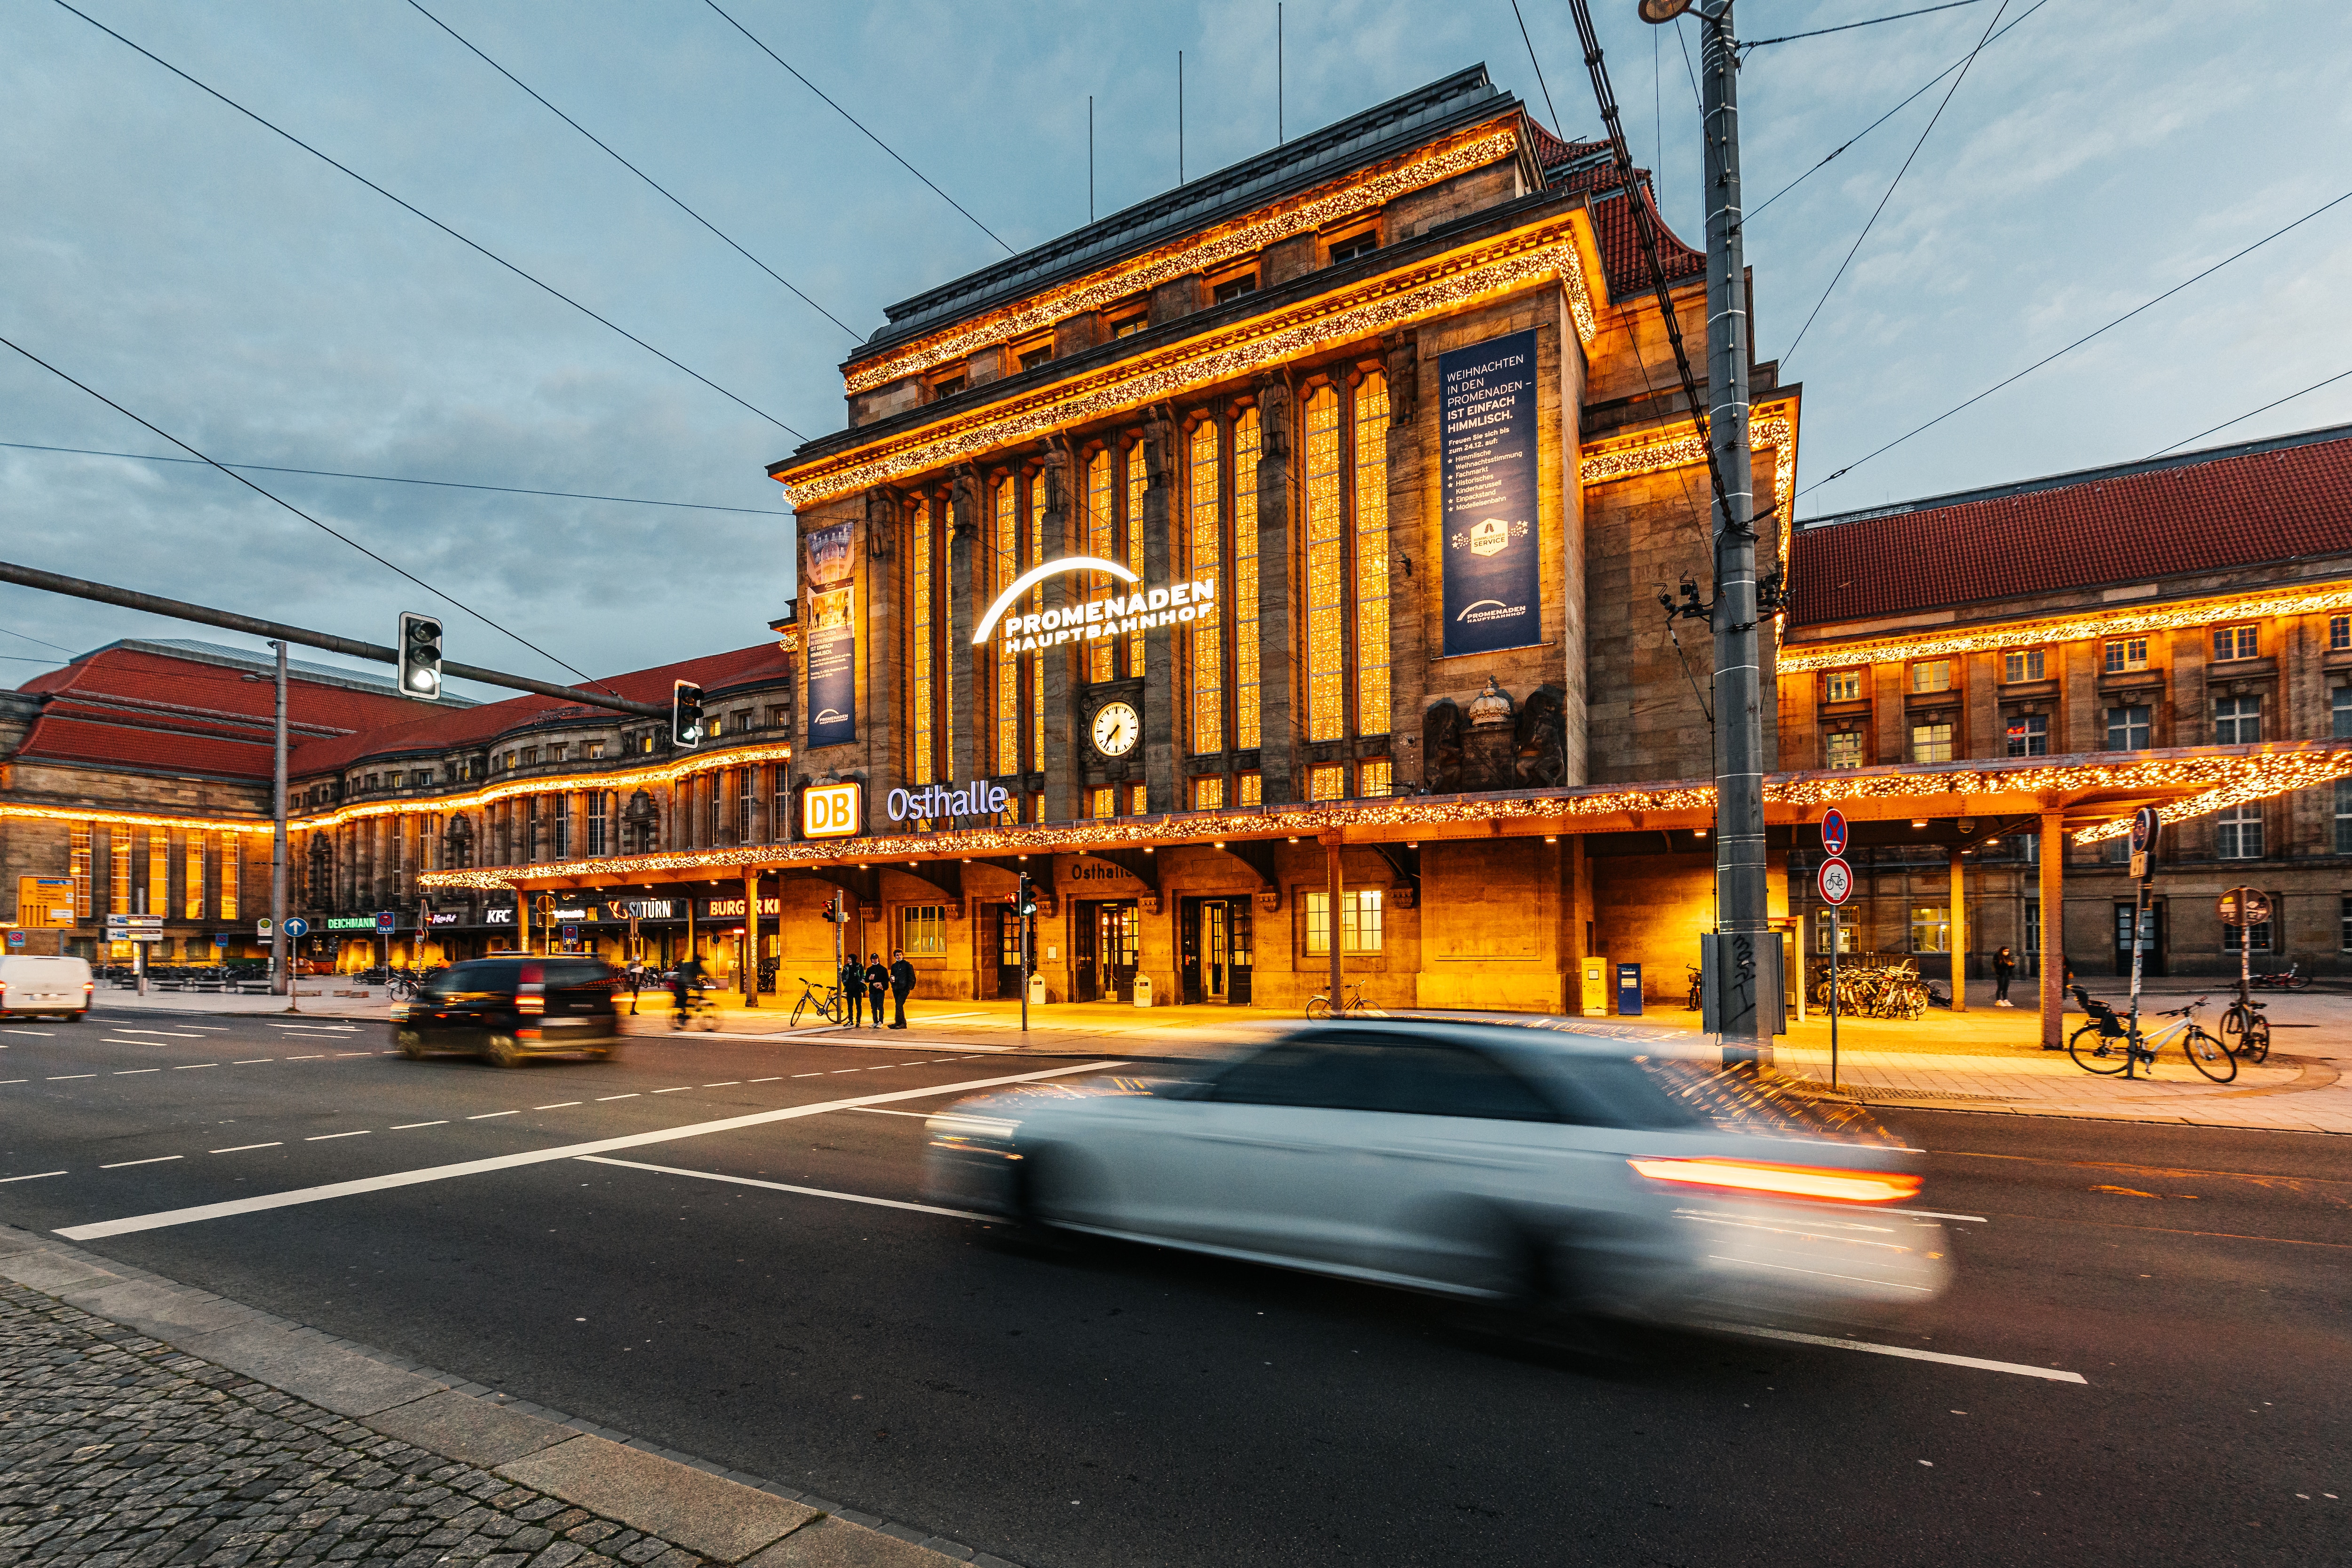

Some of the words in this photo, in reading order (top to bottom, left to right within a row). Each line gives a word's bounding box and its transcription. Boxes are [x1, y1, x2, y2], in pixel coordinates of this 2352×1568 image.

[1447, 354, 1523, 382] WEIHNACHTEN
[1448, 384, 1458, 395] IN
[1462, 377, 1484, 391] DEN
[1448, 380, 1522, 407] PROMENADEN
[1448, 408, 1464, 421] IST
[1467, 395, 1515, 416] EINFACH
[1448, 410, 1513, 434] HIMMLISCH.
[1448, 437, 1471, 446] Freuen
[1484, 430, 1498, 438] sich
[1464, 442, 1484, 451] 24.12.
[1455, 449, 1492, 462] Himmlische
[1455, 451, 1523, 470] Weihnachtsstimmung
[1455, 466, 1488, 478] Fachmarkt
[1455, 474, 1494, 487] Historisches
[1456, 479, 1502, 495] Kinderkarussell
[1456, 488, 1496, 503] Einpackstand
[1456, 496, 1506, 511] Modelleisenbahn
[1474, 533, 1505, 542] HIMMLISCHER
[1474, 537, 1505, 547] SERVICE
[1005, 578, 1214, 637] PROMENADEN
[1467, 605, 1526, 619] PROMENADEN
[1467, 611, 1526, 623] HAUPTBAHNHOF
[810, 630, 836, 639] WEIHNACHTEN
[1005, 602, 1214, 653] HAUPTBAHNHOF
[823, 633, 848, 643] PROMENADEN
[810, 649, 833, 658] HIMMLISCH.
[887, 780, 1008, 821] Osthalle
[811, 793, 850, 829] DB
[629, 900, 671, 918] SATURN
[710, 899, 762, 916] BURGR
[764, 898, 780, 914] KI
[328, 917, 376, 929] DEICHMANN
[486, 909, 512, 923] KFC
